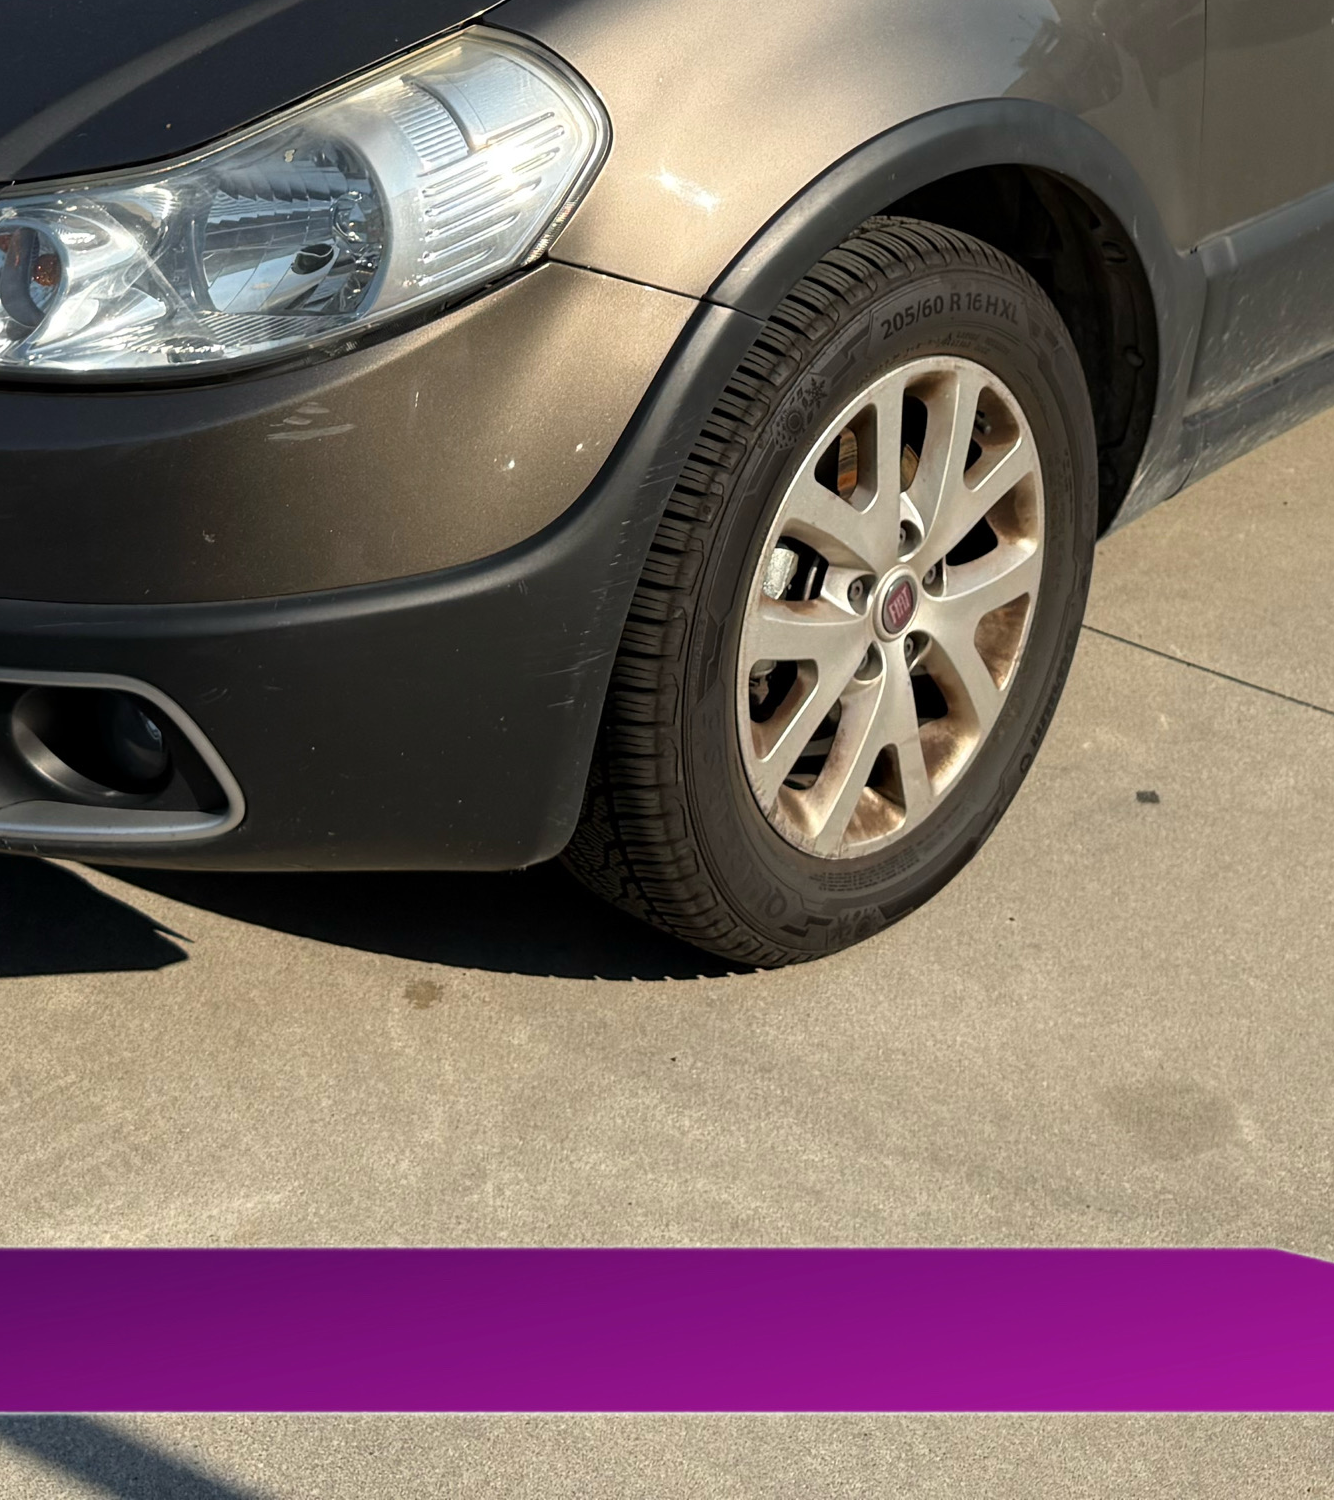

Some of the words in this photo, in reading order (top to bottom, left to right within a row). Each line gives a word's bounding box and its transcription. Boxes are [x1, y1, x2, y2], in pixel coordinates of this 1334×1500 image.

[880, 295, 944, 340] 205/60
[949, 292, 961, 311] R
[966, 291, 982, 311] 16
